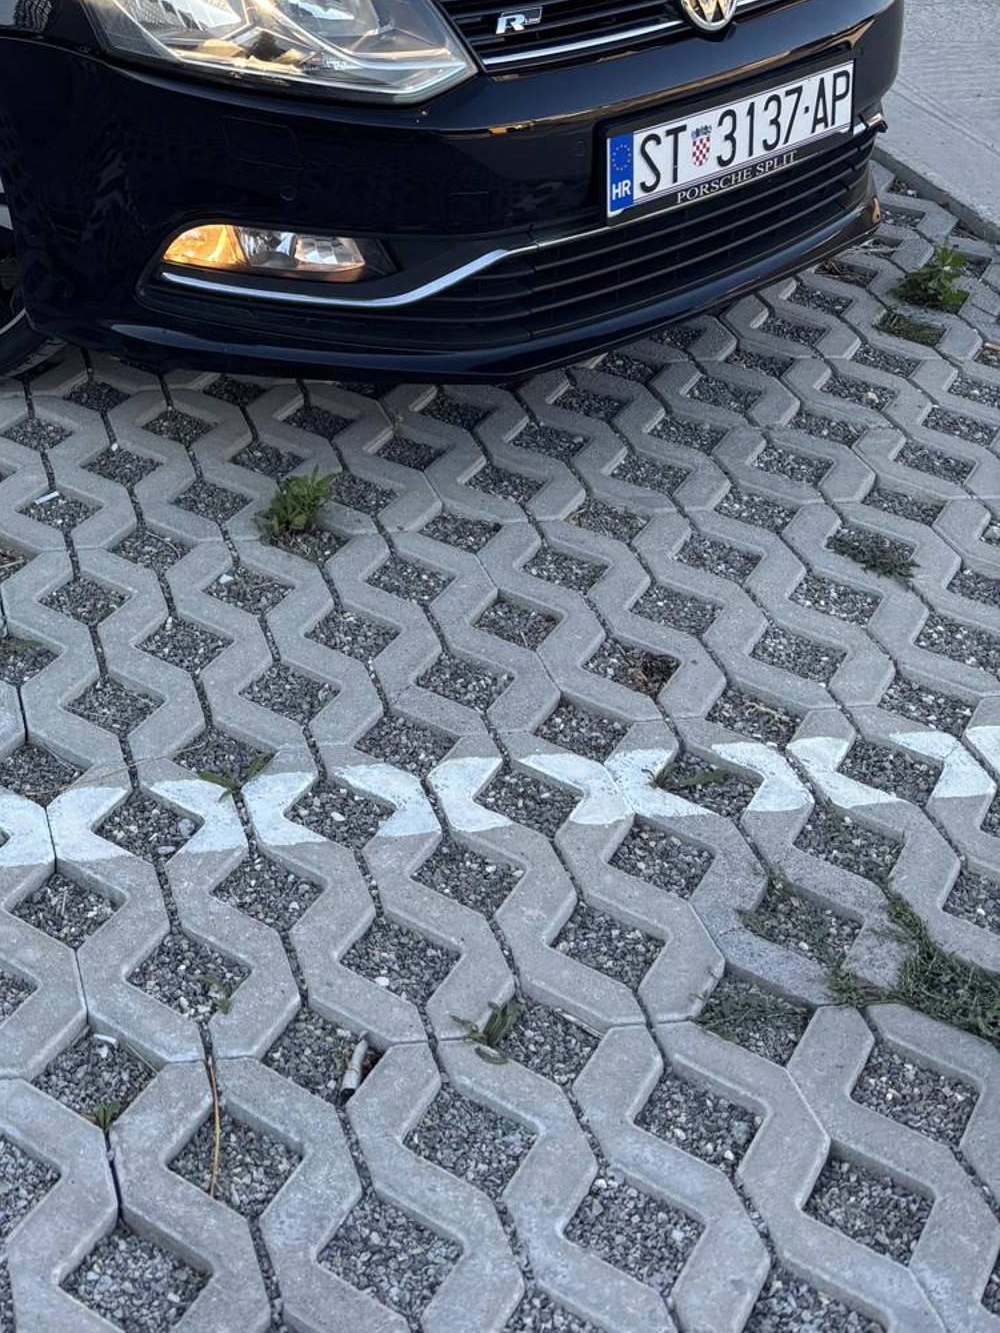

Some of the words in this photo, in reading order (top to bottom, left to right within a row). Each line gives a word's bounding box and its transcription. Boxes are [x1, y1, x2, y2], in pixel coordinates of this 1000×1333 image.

[639, 124, 688, 194] ST
[676, 167, 753, 204] PORSCHE
[755, 150, 798, 177] SPLIT
[611, 179, 632, 201] HR
